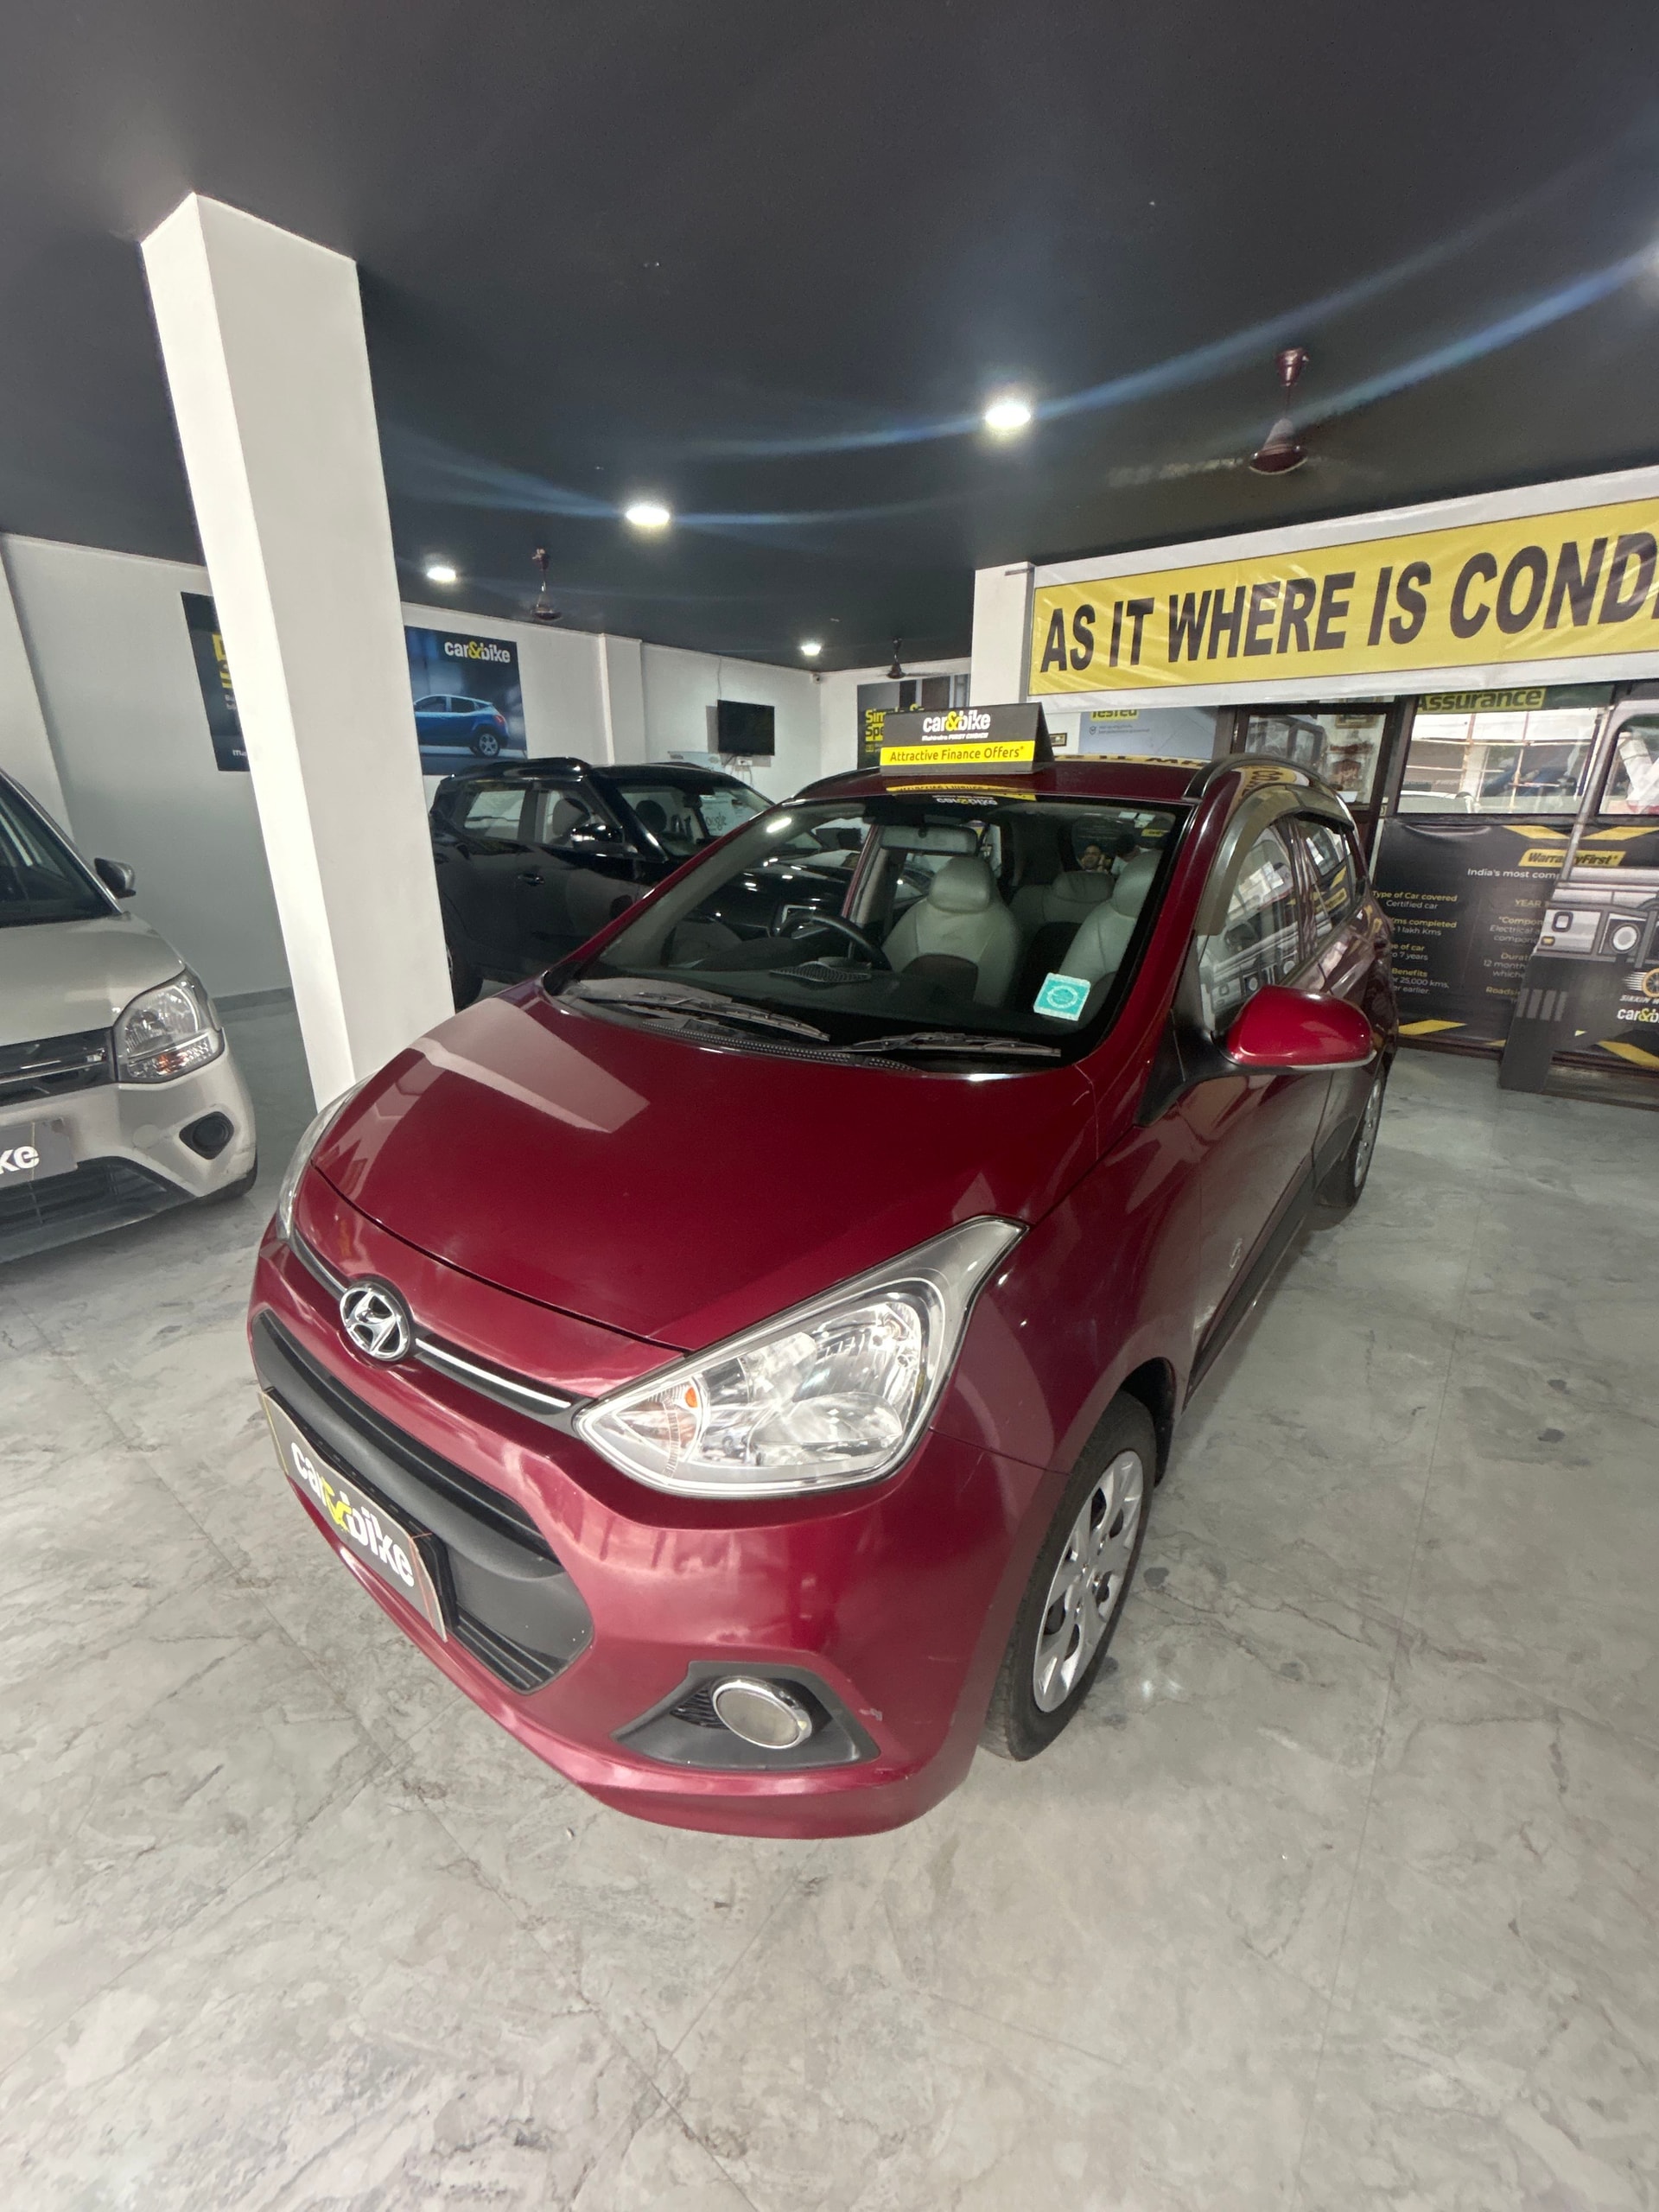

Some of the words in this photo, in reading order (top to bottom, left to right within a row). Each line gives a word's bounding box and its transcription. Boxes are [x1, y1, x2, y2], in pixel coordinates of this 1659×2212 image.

[1040, 604, 1096, 671] AS
[1109, 597, 1154, 667] IT
[1168, 571, 1356, 663] WHERE
[1367, 561, 1431, 646] IS
[1450, 531, 1659, 639] COND
[444, 641, 511, 663] car&bike
[1417, 690, 1541, 711] Assurance
[923, 709, 991, 733] car&bike
[890, 749, 938, 761] Attractive
[941, 747, 981, 760] Finance
[1467, 868, 1500, 877] India's
[1503, 870, 1529, 879] most
[1386, 899, 1422, 909] Certified
[1408, 919, 1458, 928] completed
[291, 1441, 415, 1587] car&bike
